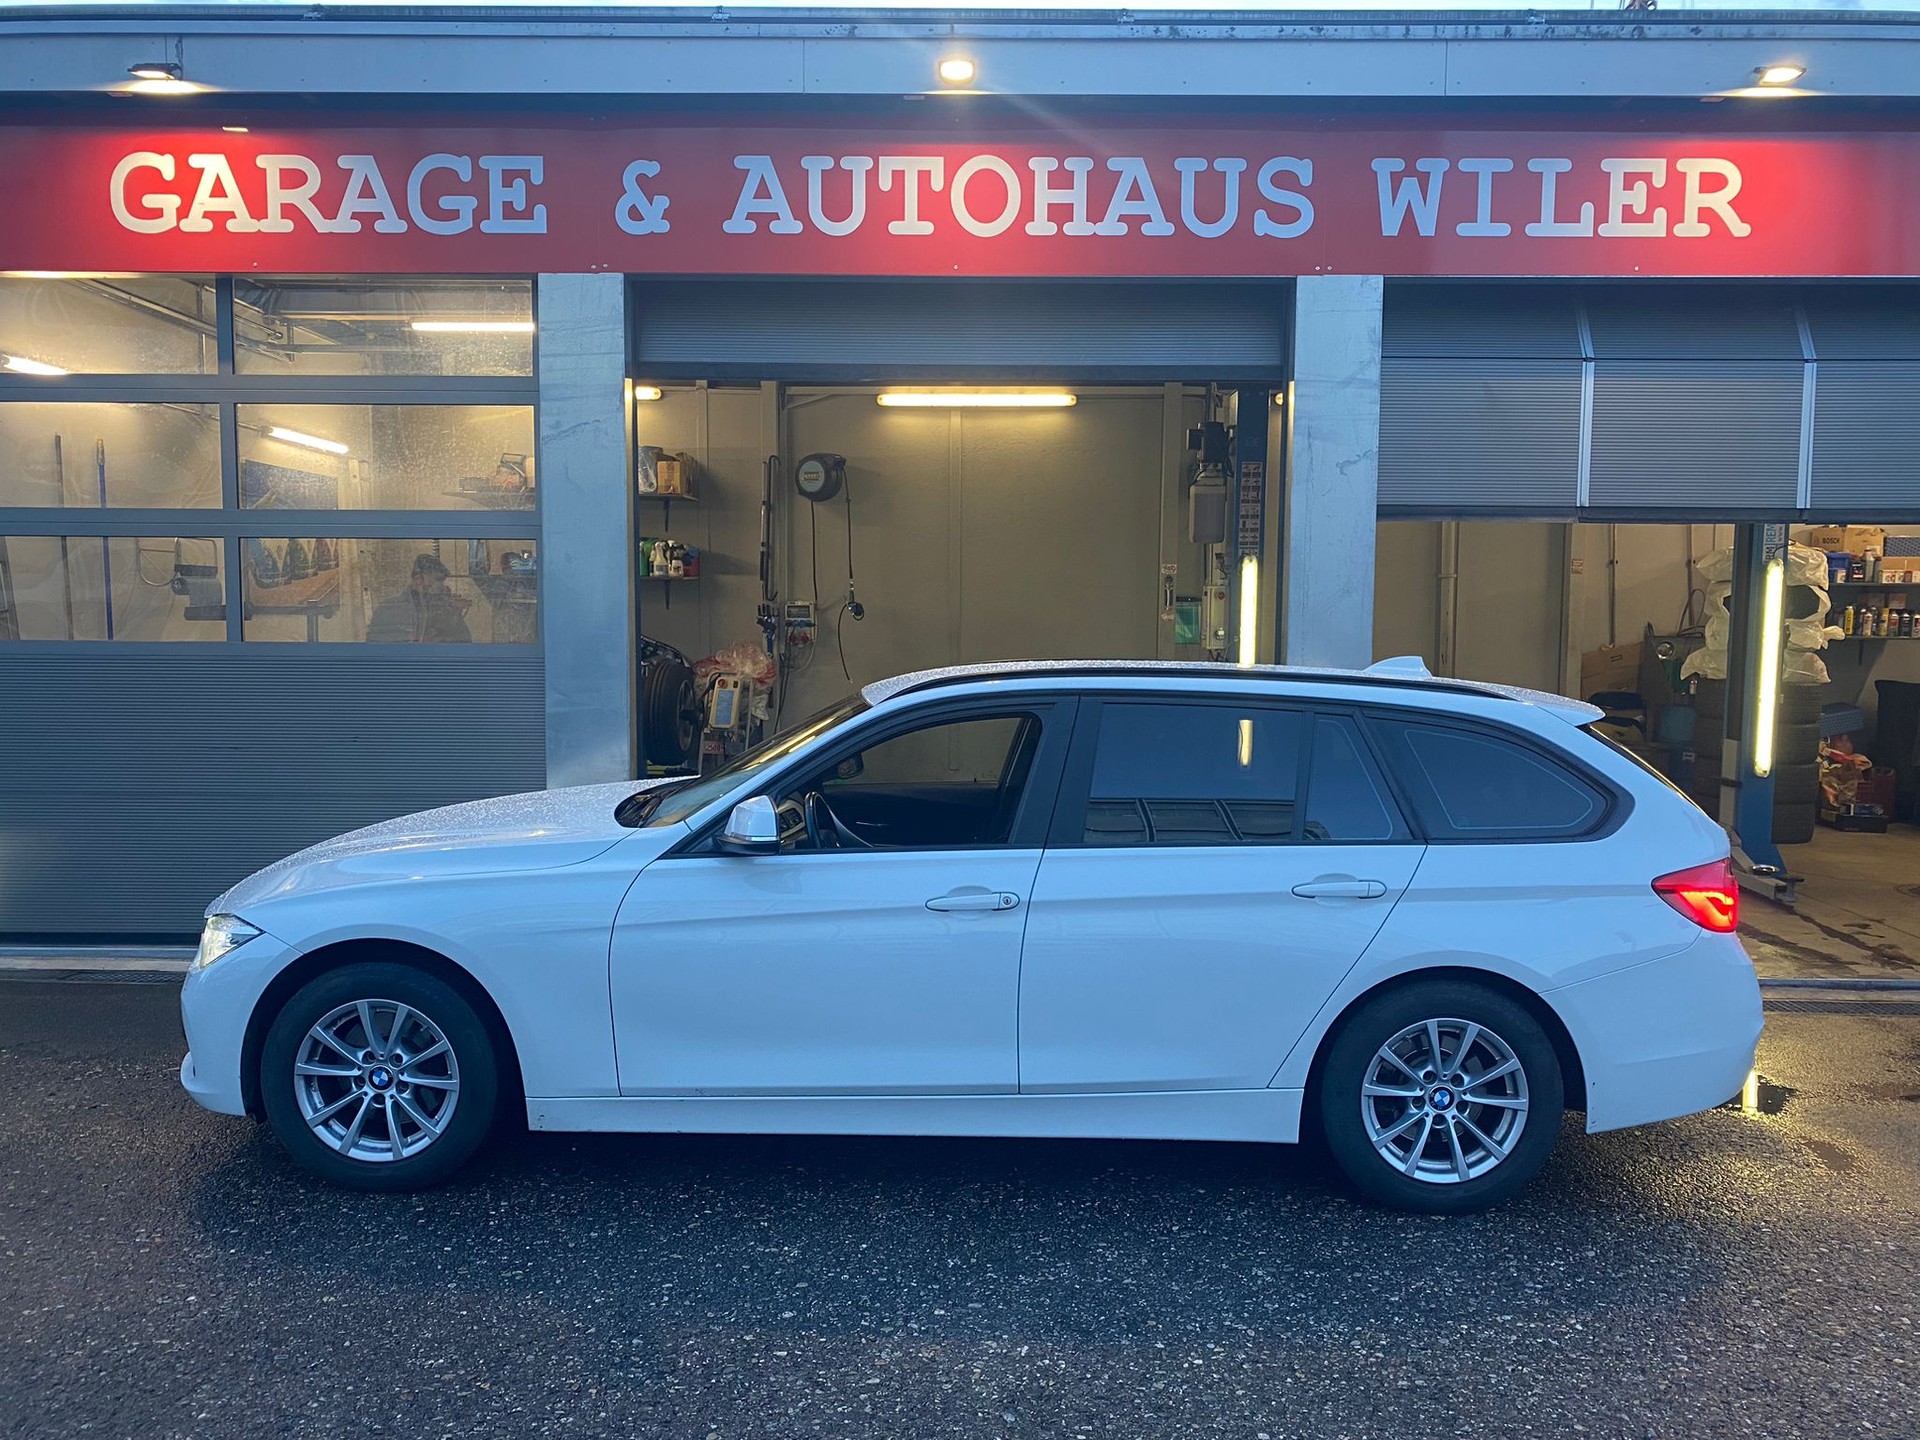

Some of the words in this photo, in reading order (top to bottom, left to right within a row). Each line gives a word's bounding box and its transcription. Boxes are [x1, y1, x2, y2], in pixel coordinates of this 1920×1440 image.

[110, 152, 548, 236] GARAGE
[614, 158, 670, 237] &
[722, 154, 1315, 239] AUTOHAUS
[1371, 157, 1752, 238] WILER
[1822, 537, 1840, 545] BOSCH
